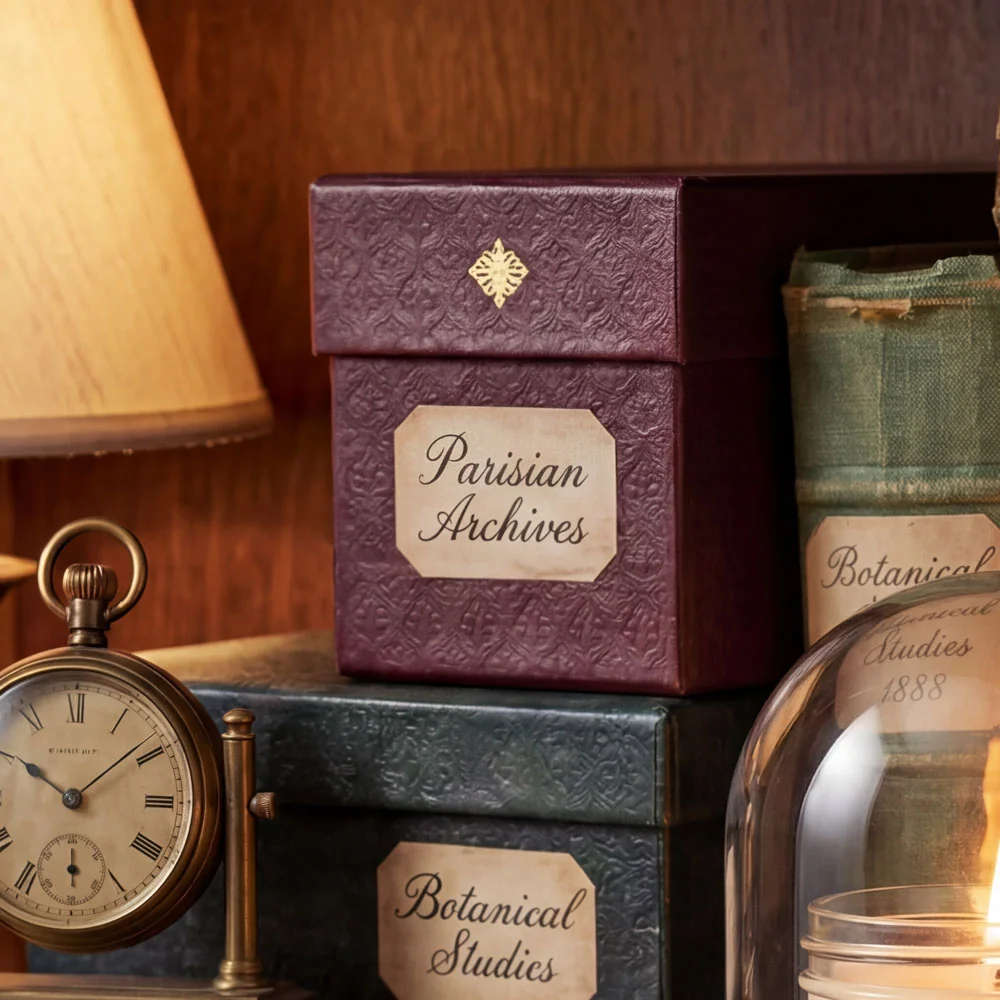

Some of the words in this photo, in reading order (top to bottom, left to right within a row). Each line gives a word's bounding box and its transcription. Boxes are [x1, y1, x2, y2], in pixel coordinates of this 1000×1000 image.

[418, 431, 589, 488] Parisian
[418, 493, 589, 545] Archives
[863, 628, 974, 666] Studies
[880, 673, 947, 704] 1888
[395, 872, 588, 930] Botanical
[427, 928, 559, 983] Studies
